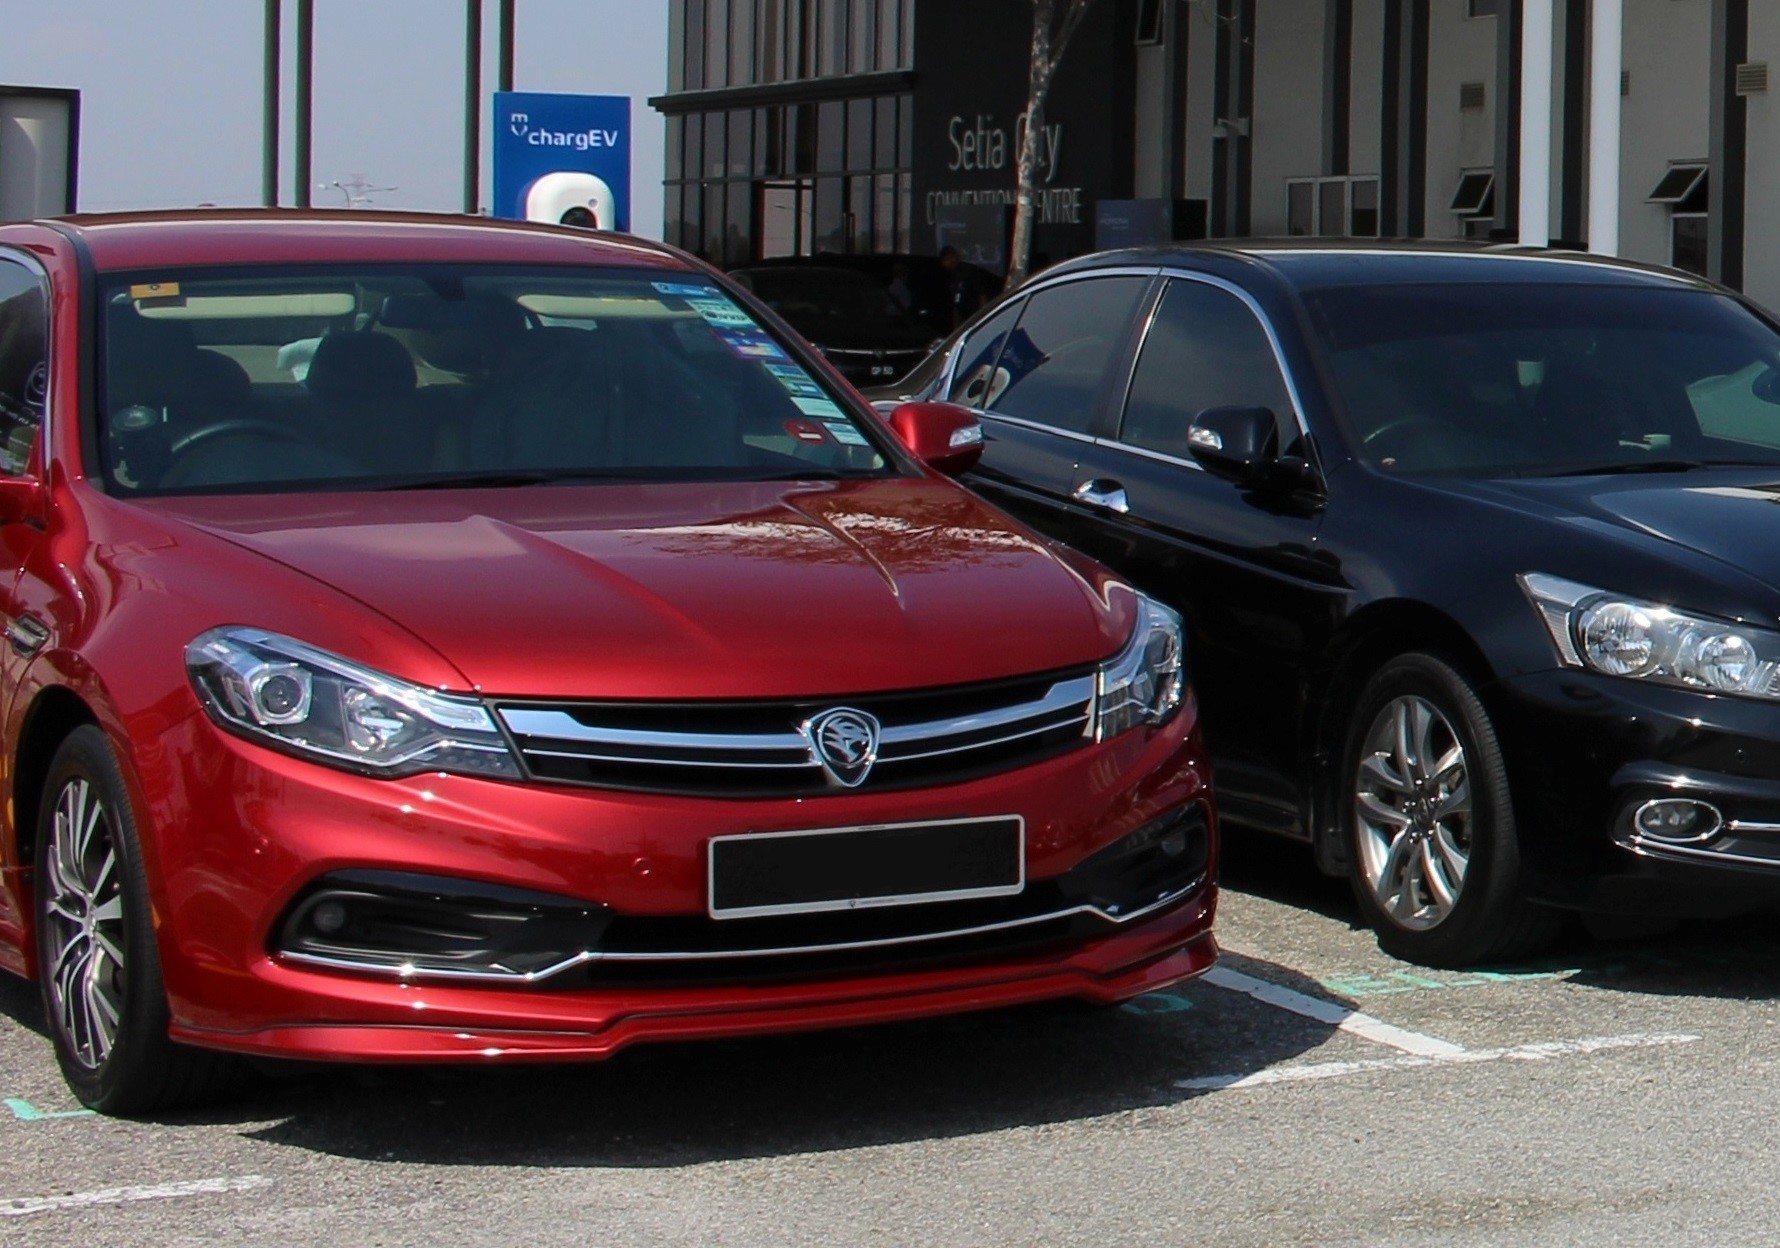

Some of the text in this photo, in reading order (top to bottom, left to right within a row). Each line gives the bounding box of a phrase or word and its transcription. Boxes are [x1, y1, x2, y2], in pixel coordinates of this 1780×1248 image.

[528, 128, 618, 151] chargEV
[948, 112, 1062, 183] Setia Cy
[1037, 187, 1082, 224] NTRE
